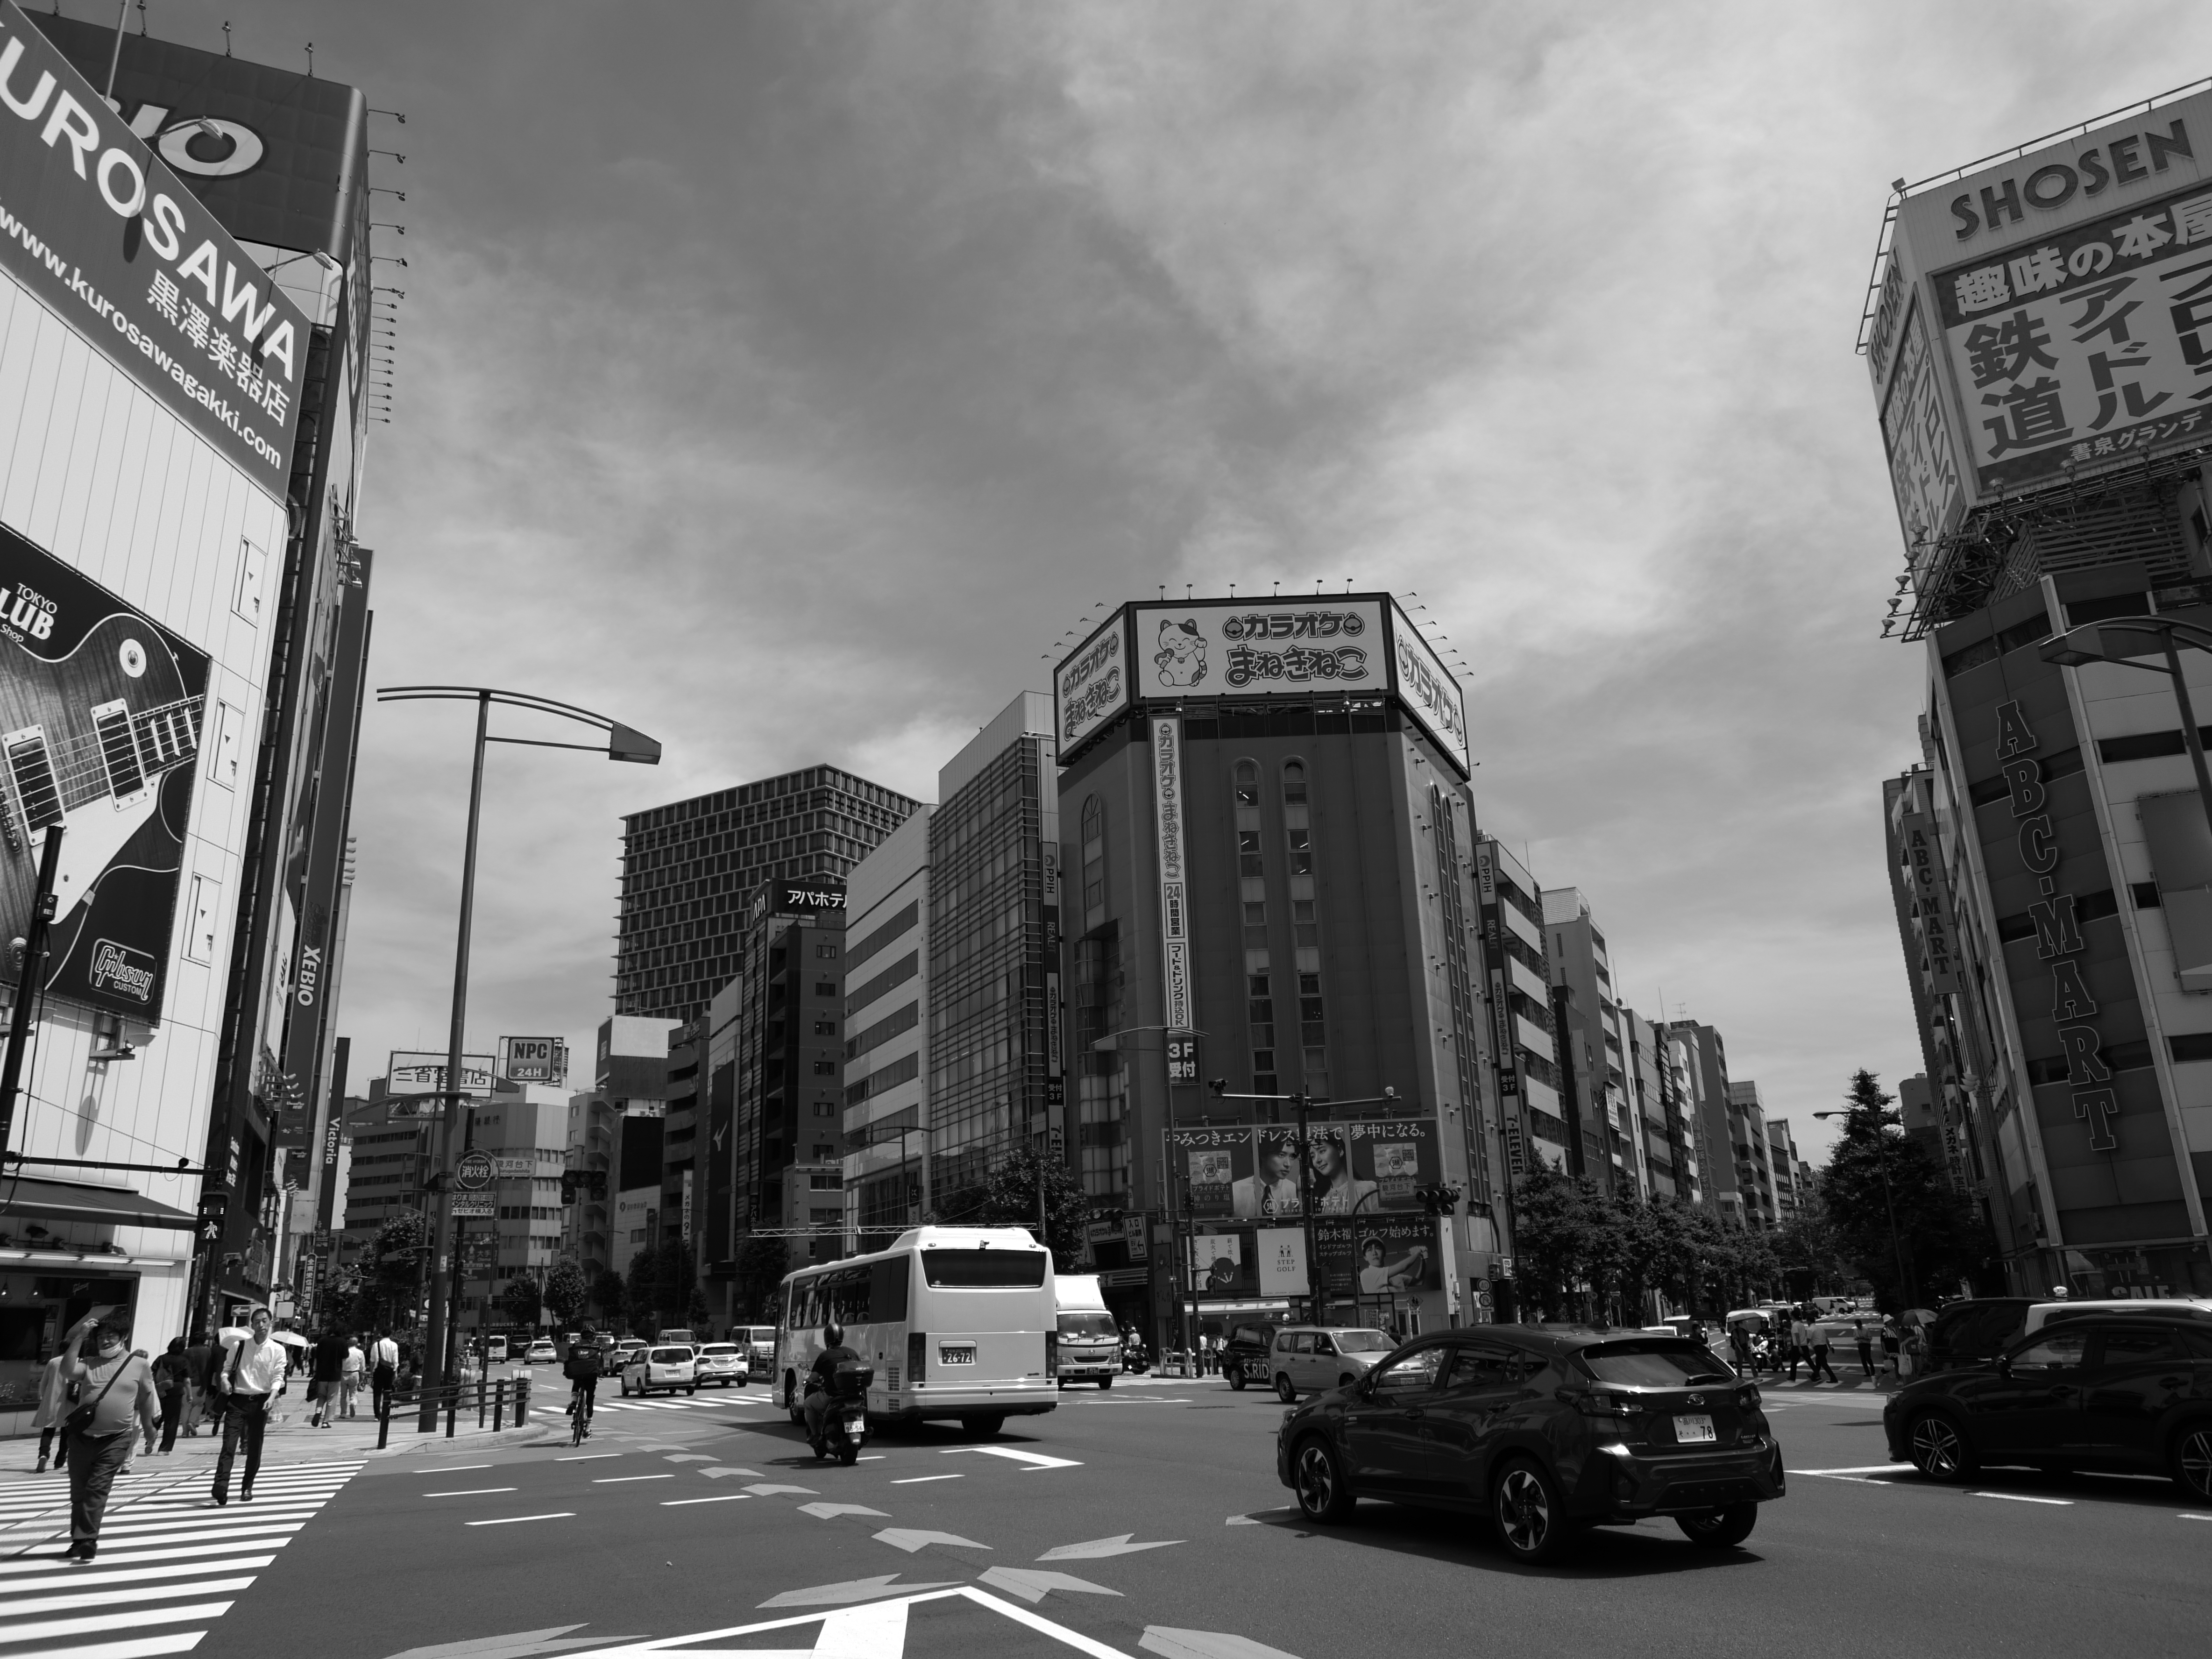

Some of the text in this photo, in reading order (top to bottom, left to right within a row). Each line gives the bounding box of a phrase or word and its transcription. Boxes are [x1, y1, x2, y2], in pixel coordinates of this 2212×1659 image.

[1950, 119, 2194, 241] SHOSEN
[0, 21, 293, 382] UROSAWA
[1871, 244, 1907, 385] SHOSEN
[0, 205, 281, 470] www.kurosawagakki.com
[147, 269, 290, 426] 黒澤楽器店
[2059, 276, 2175, 431] アイドル
[1964, 309, 2074, 460] 鉄道
[2070, 410, 2202, 461] 書泉グランデ
[16, 582, 57, 614] TOKYO
[0, 624, 24, 643] Shop
[1243, 613, 1344, 640] カラオケ
[1068, 638, 1111, 690] カラオケ
[1225, 644, 1369, 688] まねきねこ
[1063, 666, 1121, 742] まねきねこ
[1407, 643, 1456, 735] カラオケ
[1158, 736, 1177, 790] カラオケ
[1162, 802, 1180, 879] まねきねこ
[1046, 868, 1055, 894] PPIH
[1166, 886, 1181, 899] 24
[1481, 868, 1492, 894] PPIH
[1170, 899, 1181, 936] 時間営業
[95, 945, 153, 1000] Gibson
[113, 980, 142, 996] CUSTOM
[298, 944, 321, 1007] XEBIO
[514, 1042, 547, 1059] NPC
[1168, 1043, 1194, 1059] 3F
[517, 1068, 542, 1077] 24H
[1048, 1084, 1063, 1092] 受付
[1169, 1061, 1196, 1078] 受付
[1500, 1074, 1515, 1084] 受付
[326, 1117, 341, 1164] Victoria
[1506, 1114, 1524, 1175] 7-ELEVEn
[461, 1165, 489, 1178] 消火栓
[1281, 1196, 1348, 1209] プラポテト
[1129, 1219, 1139, 1228] 入口
[947, 1353, 972, 1363] 26-72
[1700, 1425, 1713, 1439] 78
